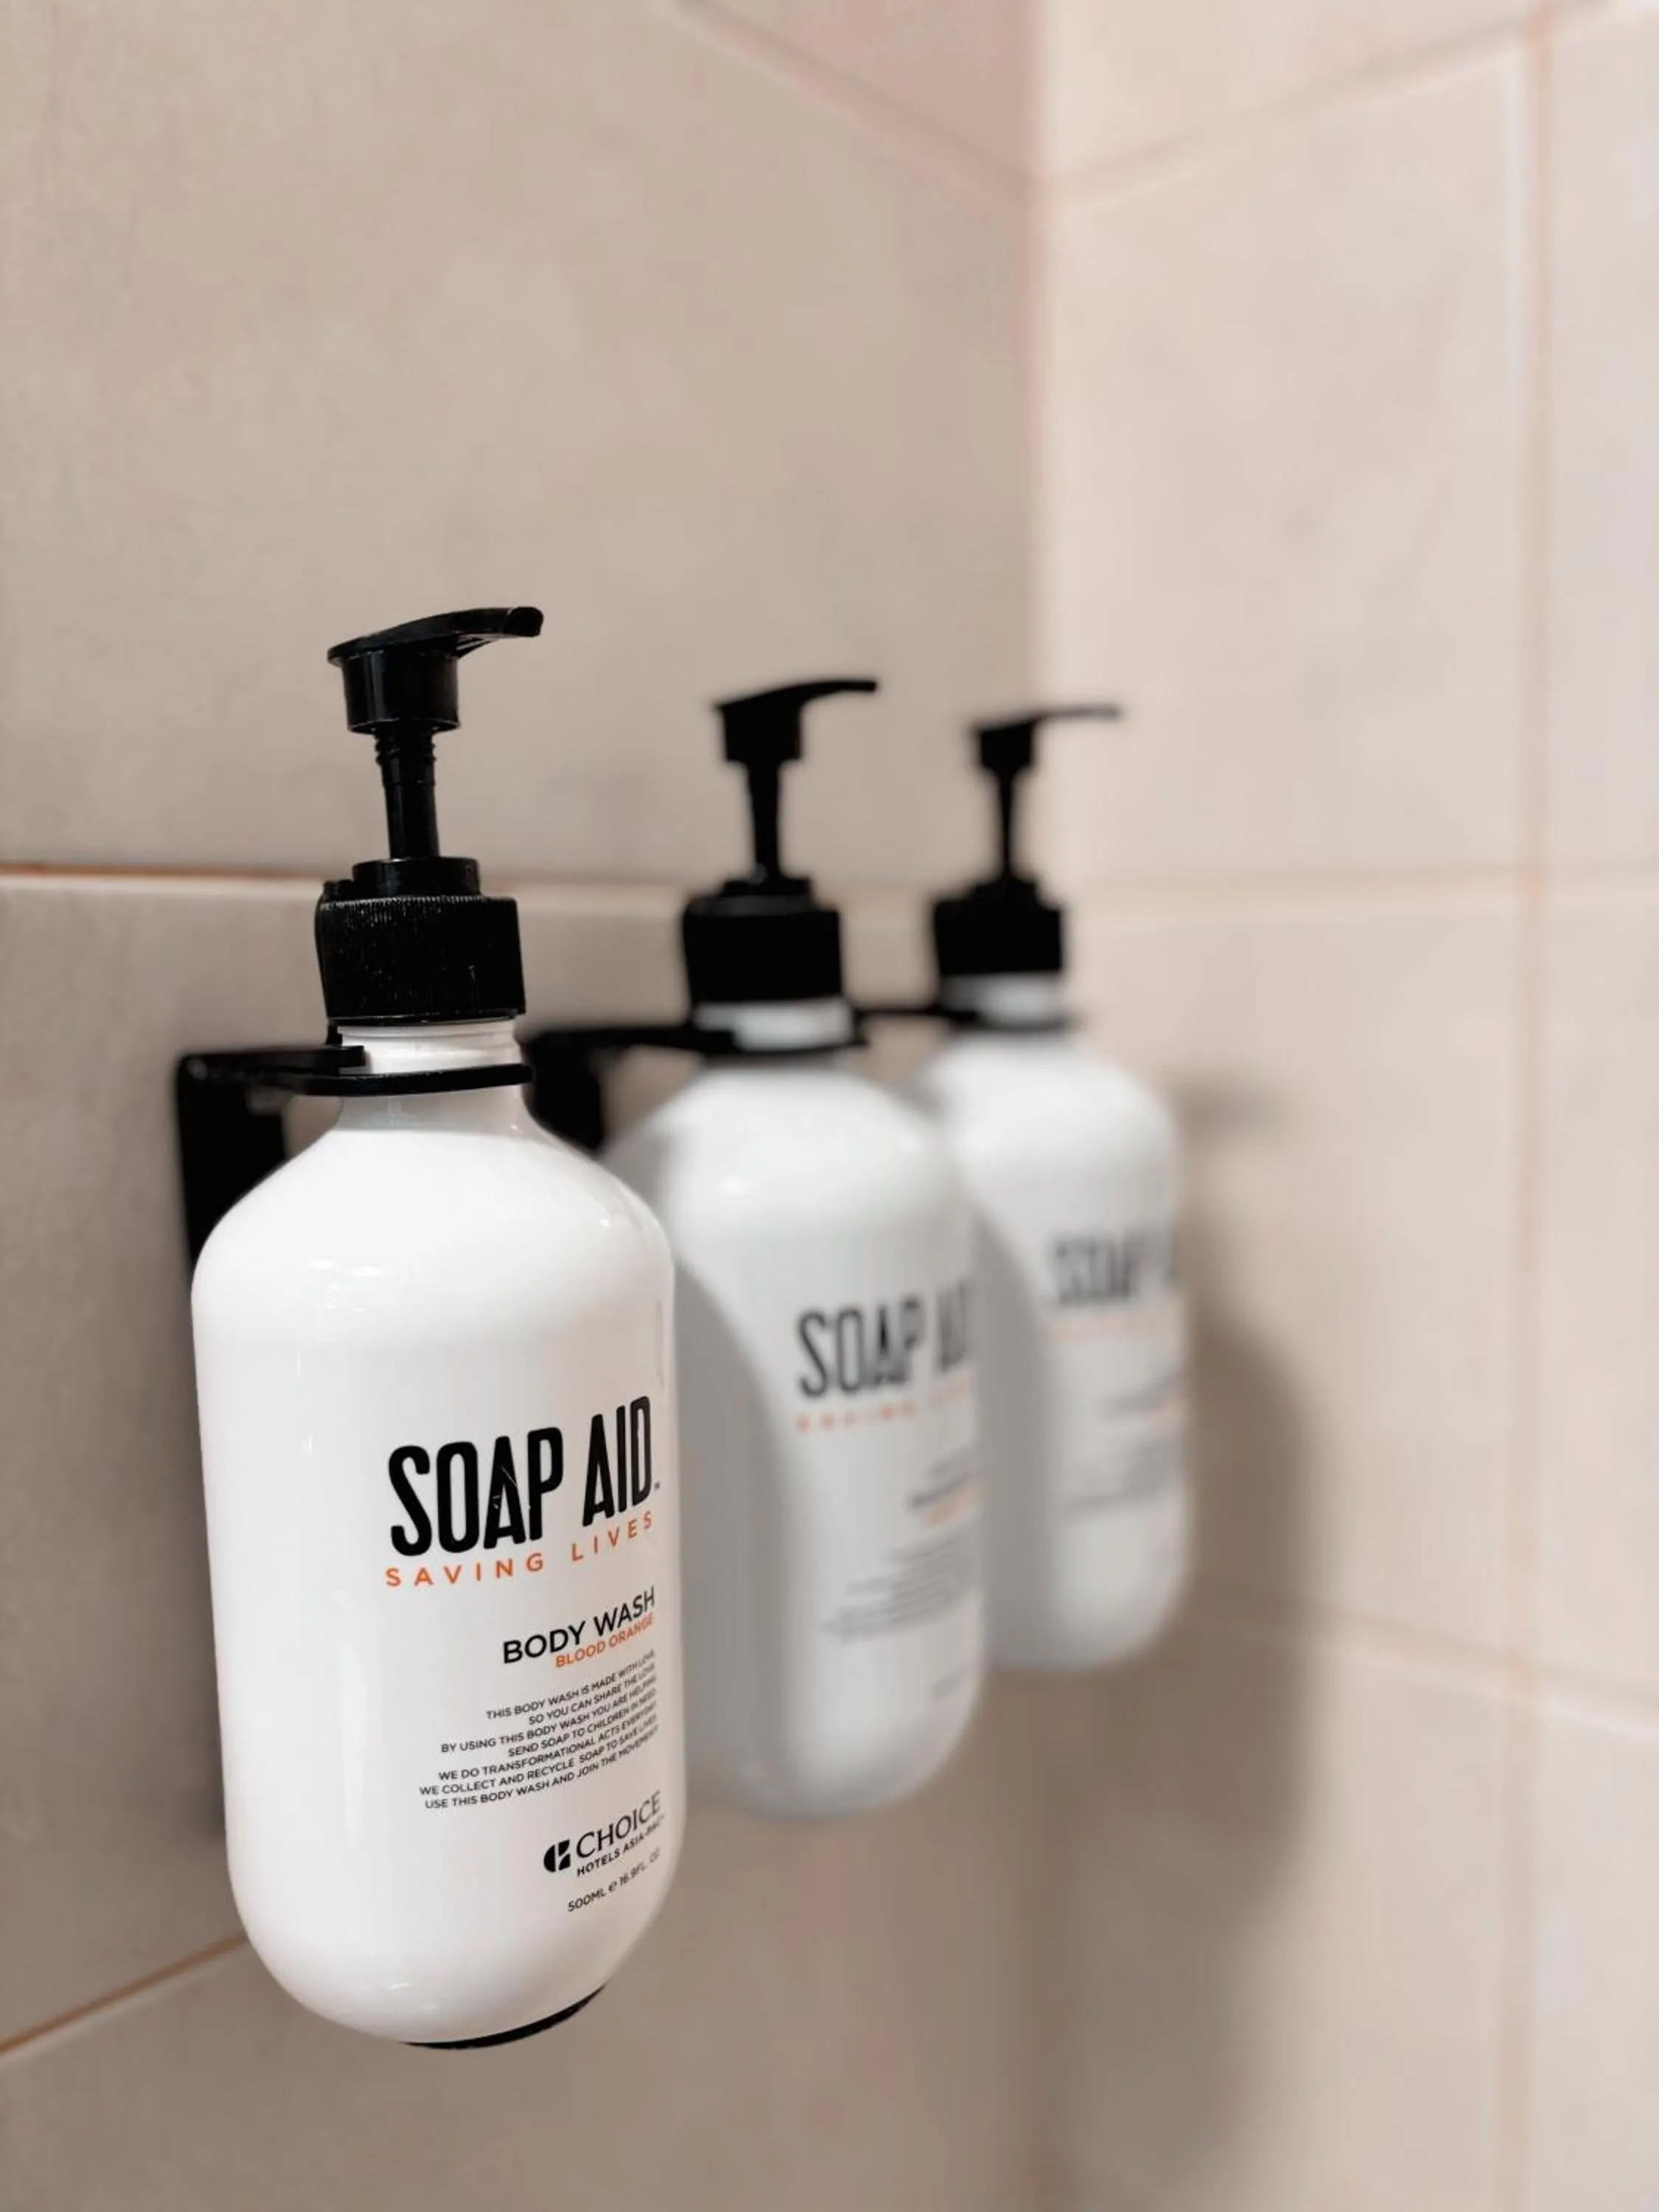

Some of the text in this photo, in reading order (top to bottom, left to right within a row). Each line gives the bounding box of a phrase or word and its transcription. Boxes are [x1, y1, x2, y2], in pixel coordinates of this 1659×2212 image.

[797, 1295, 922, 1397] SOAP
[389, 1427, 563, 1556] SOAP
[386, 1511, 652, 1587] SAVING LIVES
[503, 1585, 655, 1663] BODY WASH
[555, 1613, 653, 1667] BLOOD ORANGE
[486, 1708, 512, 1719] THIS
[515, 1700, 545, 1714] BODY
[549, 1689, 579, 1705] WASH
[581, 1686, 590, 1695] IS
[591, 1673, 616, 1691] MADE
[619, 1661, 638, 1677] WITH
[529, 1714, 544, 1725] SO
[546, 1706, 568, 1719] YOU
[571, 1699, 592, 1713] CAN
[594, 1684, 622, 1703] SHARE
[624, 1675, 637, 1688] THE
[441, 1743, 456, 1753] BY
[459, 1738, 496, 1751] USING
[499, 1733, 524, 1745] THIS
[527, 1724, 557, 1739] BODY
[559, 1713, 590, 1729] WASH
[591, 1703, 611, 1718] YOU
[613, 1693, 627, 1707] ARE
[508, 1742, 538, 1757] SEND
[541, 1733, 570, 1748] SOAP
[572, 1728, 585, 1739] TO
[587, 1708, 630, 1733] CHILDREN
[420, 1786, 439, 1795] WE
[442, 1778, 496, 1794] COLLECT
[499, 1773, 524, 1786] AND
[527, 1758, 574, 1780] RECYCLE
[580, 1745, 605, 1763] SOAP
[606, 1739, 618, 1750] TO
[619, 1728, 637, 1745] SAVE
[425, 1798, 448, 1809] USE
[452, 1795, 478, 1806] THIS
[480, 1789, 514, 1803] BODY
[516, 1779, 549, 1796] WASH
[552, 1772, 574, 1787] AND
[577, 1761, 599, 1778] JOIN
[601, 1753, 616, 1767] THE
[439, 1770, 458, 1781] WE
[461, 1768, 479, 1778] DO
[481, 1736, 596, 1775] TRANSFORMATIONAL
[598, 1725, 620, 1741] ACTS
[577, 1790, 661, 1858] CHOICE
[576, 1847, 620, 1877] HOTELS
[567, 1888, 607, 1912] 500ML
